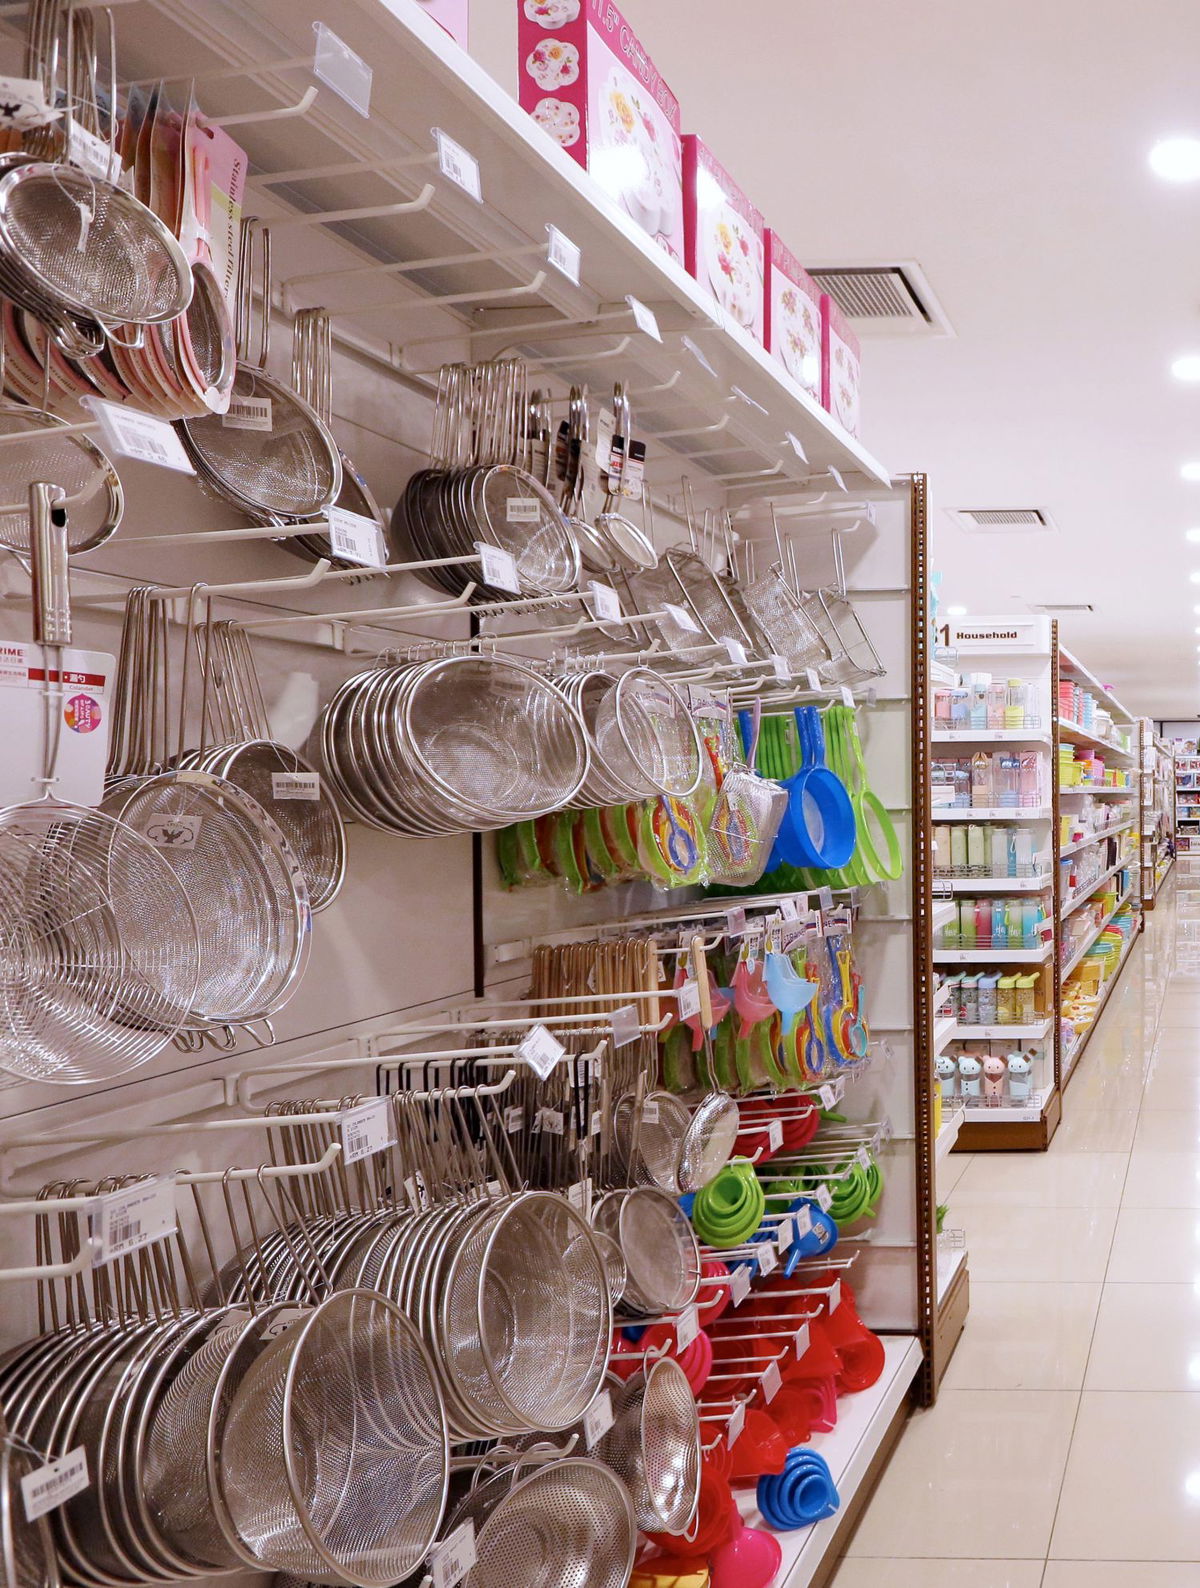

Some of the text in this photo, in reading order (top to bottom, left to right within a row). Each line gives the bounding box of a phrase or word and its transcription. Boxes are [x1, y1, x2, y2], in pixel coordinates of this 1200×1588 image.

[228, 158, 241, 222] Stainless
[226, 223, 235, 258] steel
[956, 631, 1018, 640] Household
